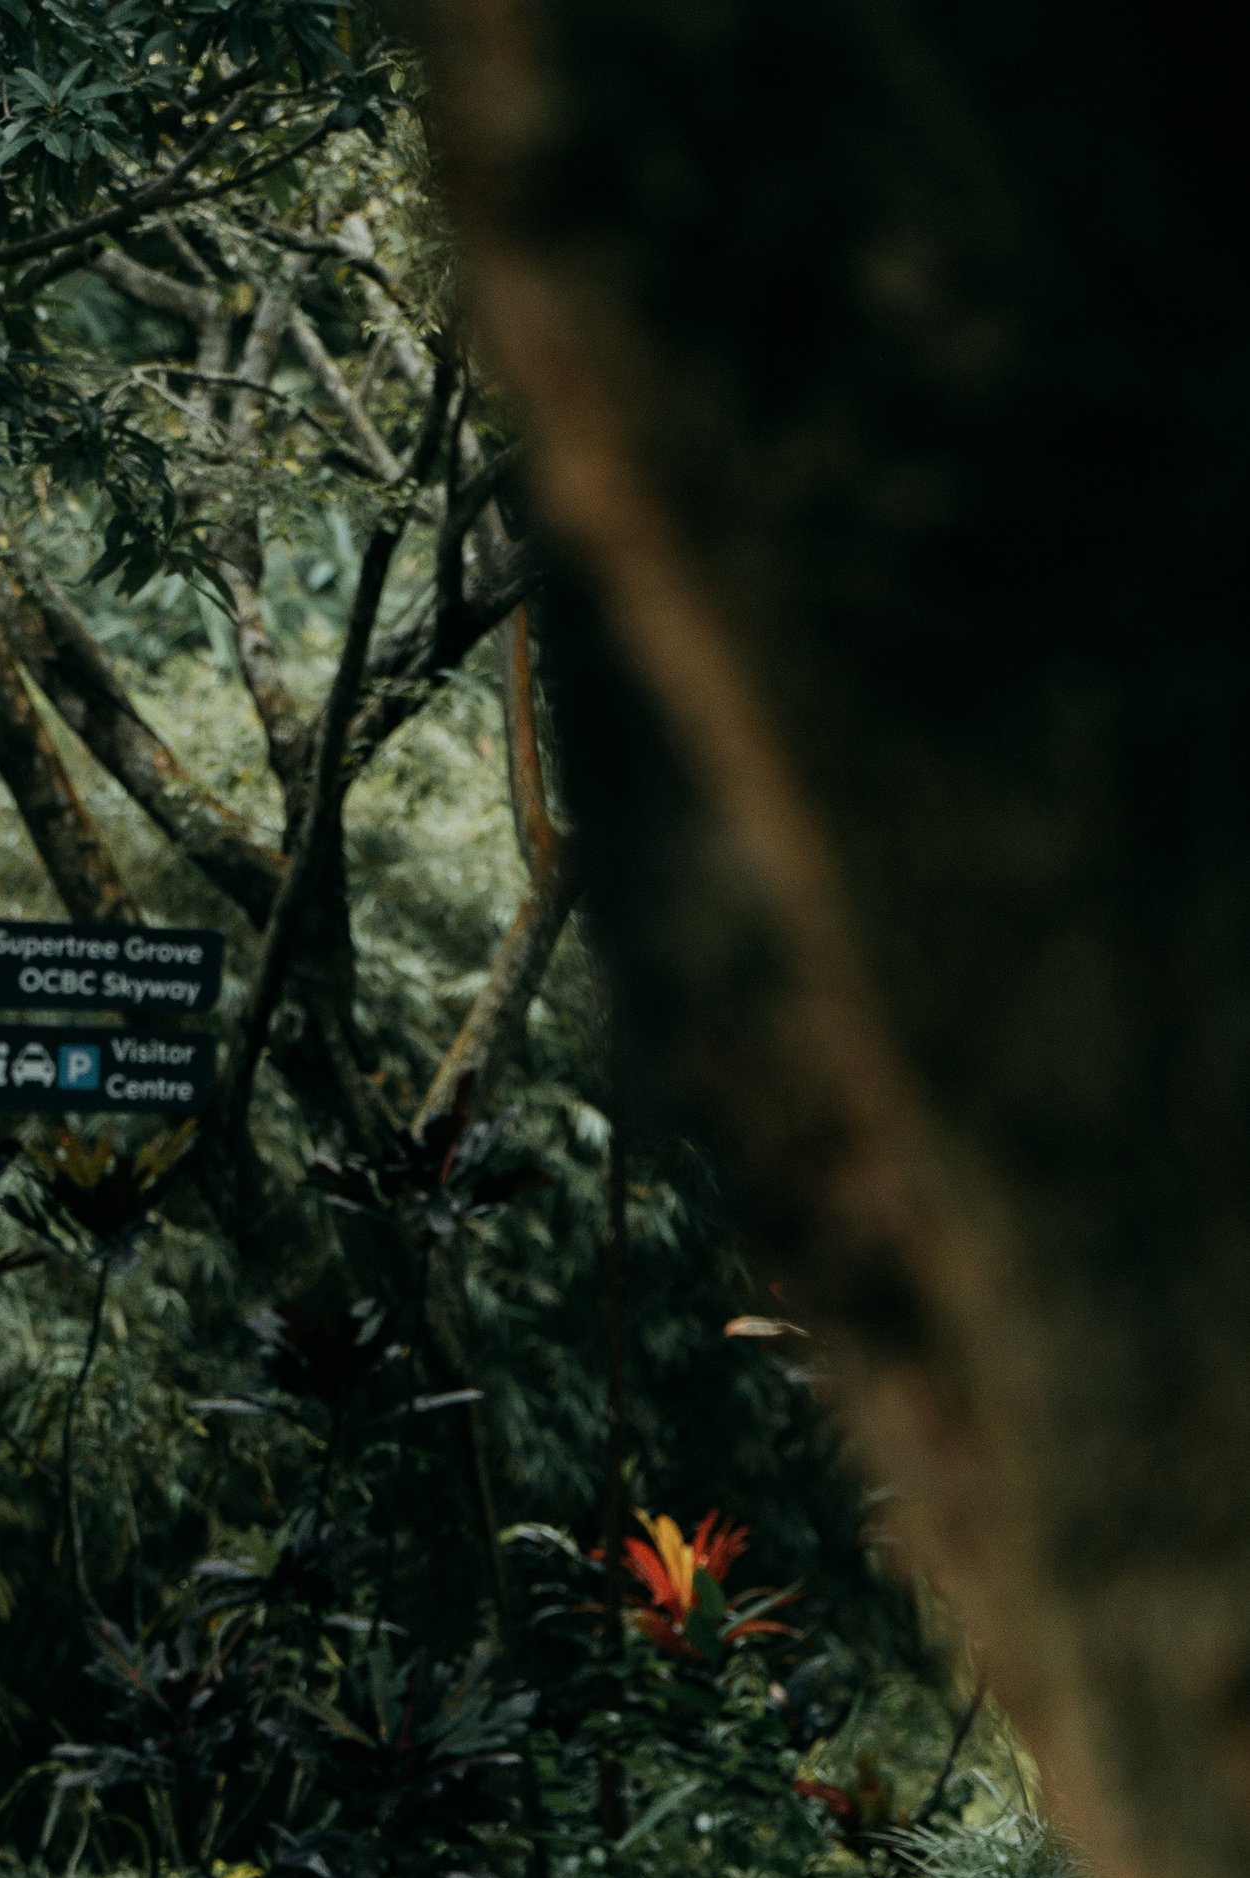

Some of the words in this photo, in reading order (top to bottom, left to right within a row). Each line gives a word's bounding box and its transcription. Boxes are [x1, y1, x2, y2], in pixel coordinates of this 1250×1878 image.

[124, 935, 204, 965] Grove
[18, 966, 98, 996] OCBC
[102, 970, 202, 1006] Skyway
[110, 1036, 197, 1065] Visitor
[105, 1073, 194, 1101] Centre
